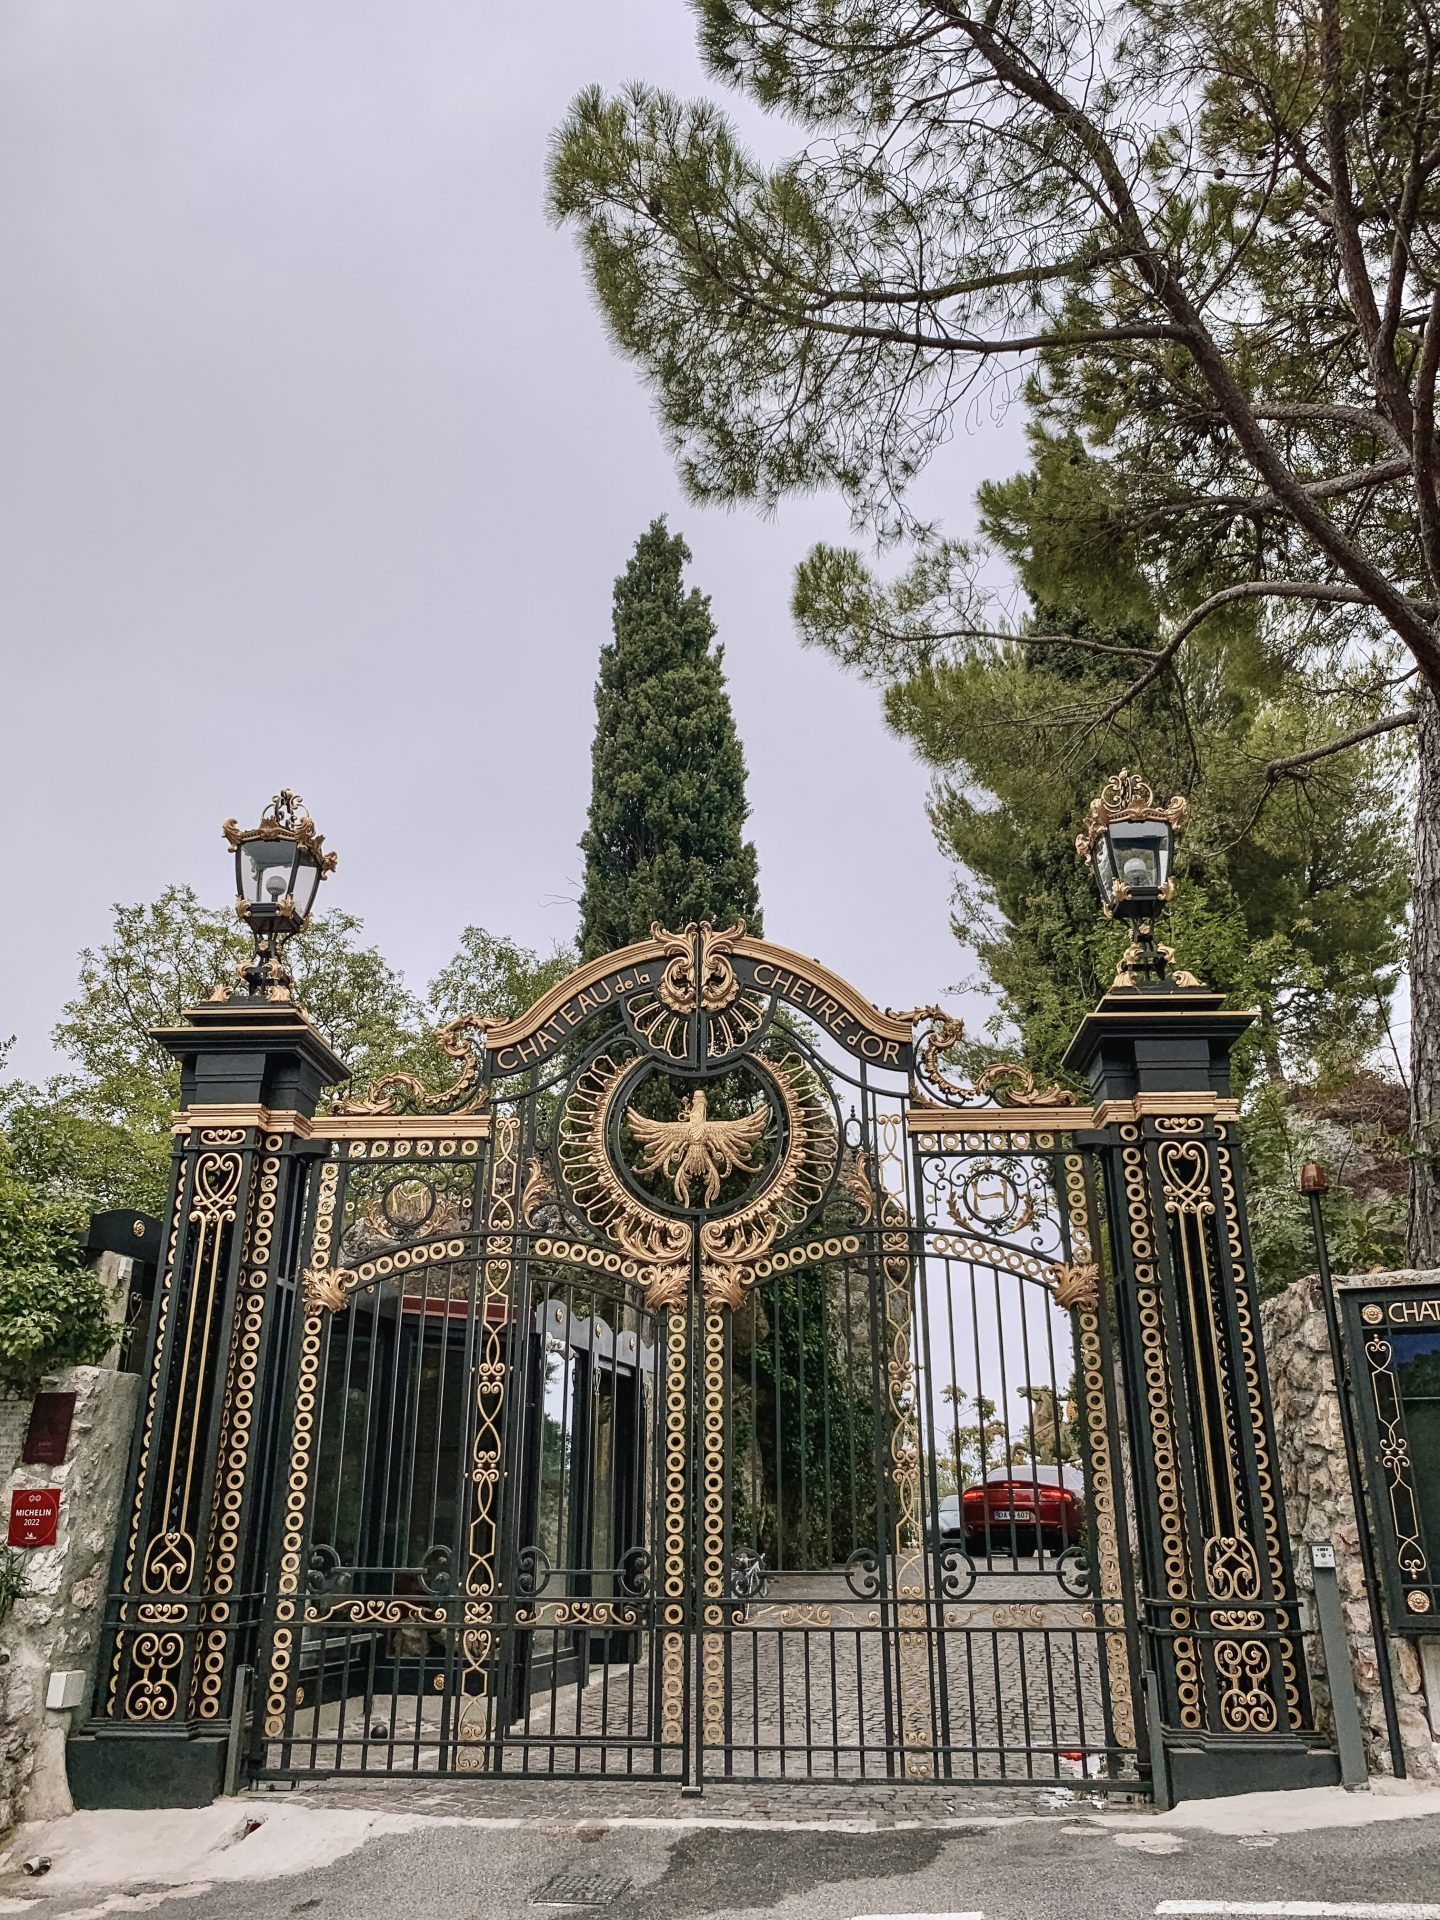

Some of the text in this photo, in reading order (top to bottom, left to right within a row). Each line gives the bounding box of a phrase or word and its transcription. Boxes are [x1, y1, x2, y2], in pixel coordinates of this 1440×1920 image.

[497, 964, 900, 1070] CHATEAU de la CHEVRE d'OR
[15, 1508, 52, 1517] MICHELIN
[23, 1518, 40, 1526] 2022
